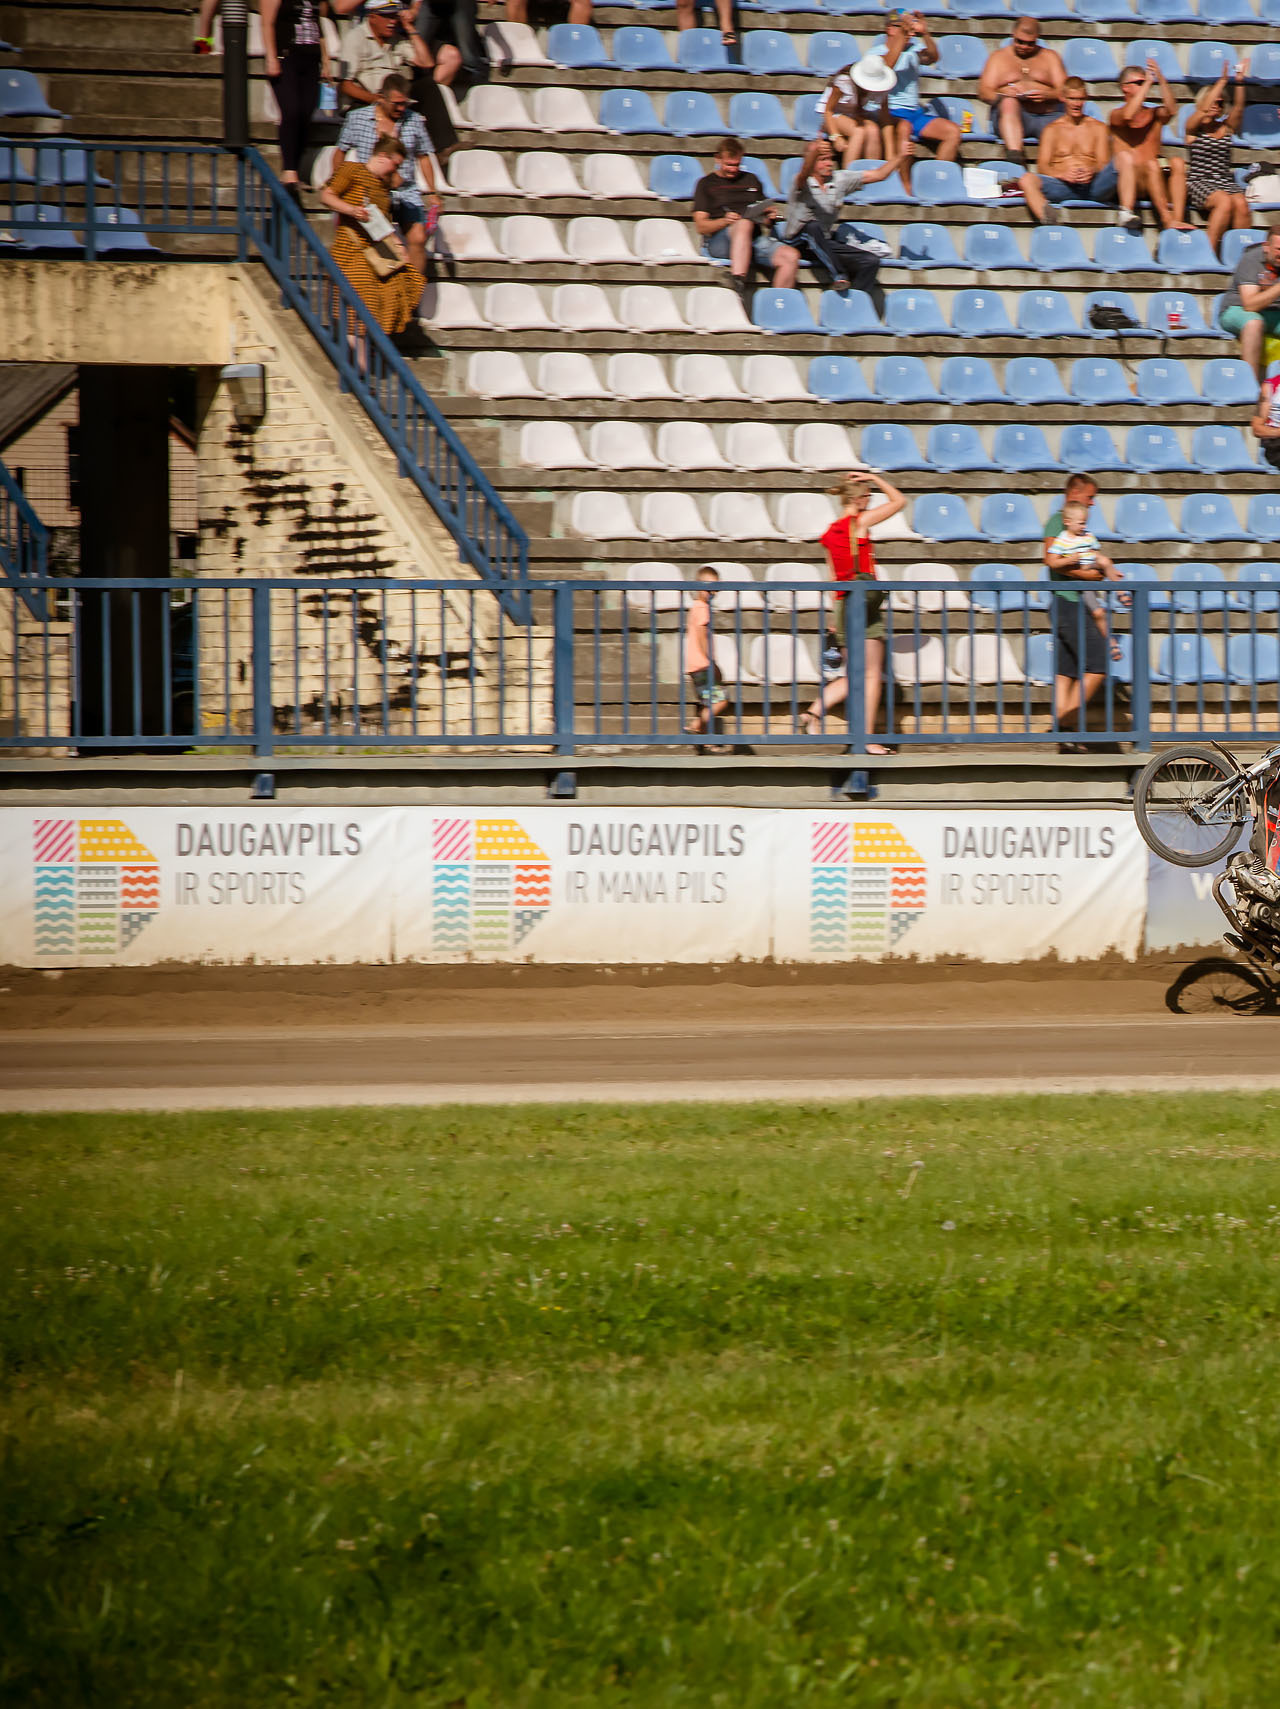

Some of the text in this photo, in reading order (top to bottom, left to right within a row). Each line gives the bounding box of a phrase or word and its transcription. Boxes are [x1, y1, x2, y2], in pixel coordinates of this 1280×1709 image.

[175, 822, 362, 857] DAUGAVPILS
[567, 823, 745, 858] DAUGAVPILS
[943, 825, 1115, 859] DAUGAVPILS
[175, 871, 306, 905] IR SPORTS
[566, 871, 727, 904] IR MANA PILS
[941, 872, 1062, 905] IR SPORTS
